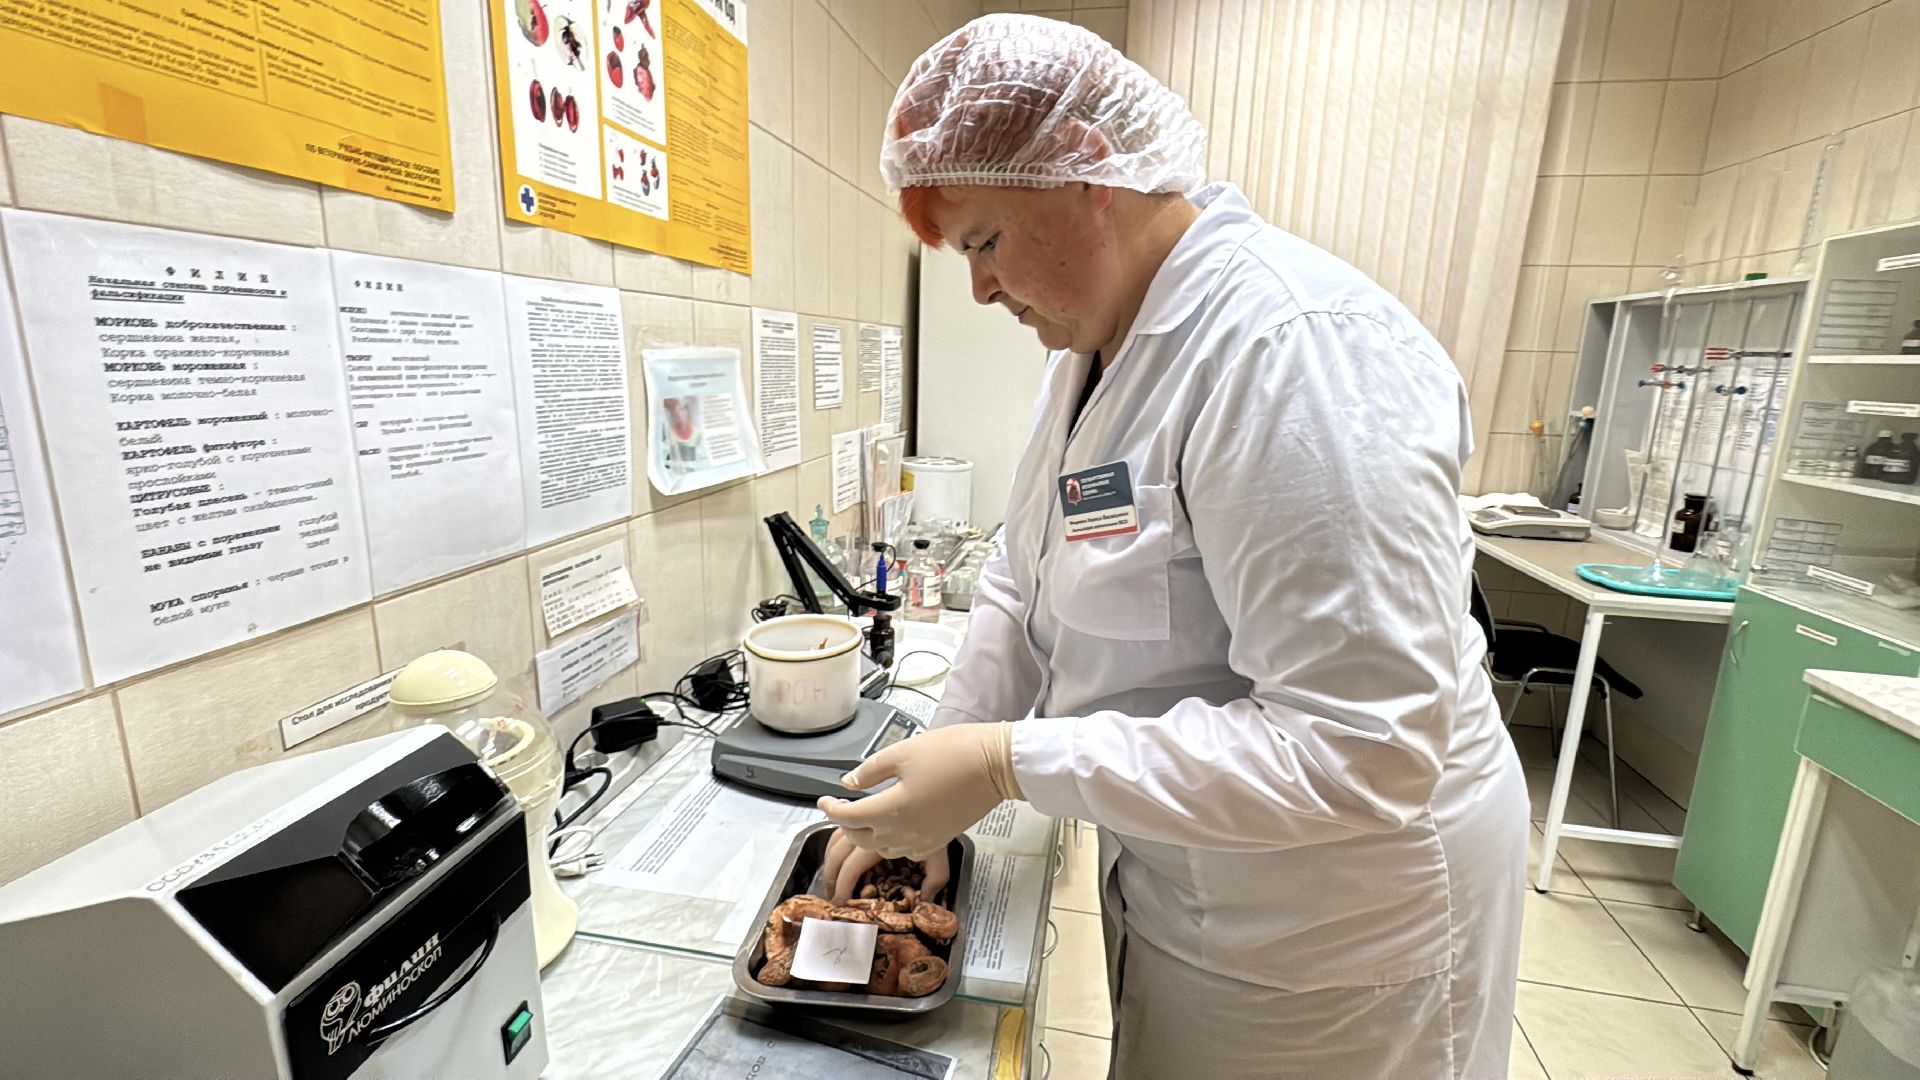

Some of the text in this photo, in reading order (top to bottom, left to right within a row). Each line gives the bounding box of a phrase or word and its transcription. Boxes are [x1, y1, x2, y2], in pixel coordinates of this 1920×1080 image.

[162, 281, 208, 291] степень
[94, 317, 158, 328] МОРКОВЬ
[165, 319, 287, 331] доброкачественная
[101, 347, 290, 360] Корка оранжево-коричневая
[103, 361, 166, 373] МОРКОВЬ
[110, 388, 257, 405] Корка молочно-белая
[116, 417, 192, 431] КАРТОФЕЛЬ
[119, 433, 163, 447] белый
[121, 444, 197, 461] КАРТОФЕЛЬ
[125, 455, 221, 477] ярко-голубой
[130, 483, 212, 504] ЦИТРУСОВЫЕ
[132, 501, 192, 517] Голубая
[197, 492, 249, 508] плесень
[136, 518, 170, 532] цвет
[141, 541, 192, 560] БАНАНЫ
[144, 562, 162, 573] не
[228, 541, 264, 556] глазу
[150, 596, 185, 613] МУКА
[153, 600, 231, 627] белой муке
[292, 710, 315, 726] Стол
[316, 703, 334, 718] для
[347, 944, 442, 1043] ЛЮМИНОСКОП
